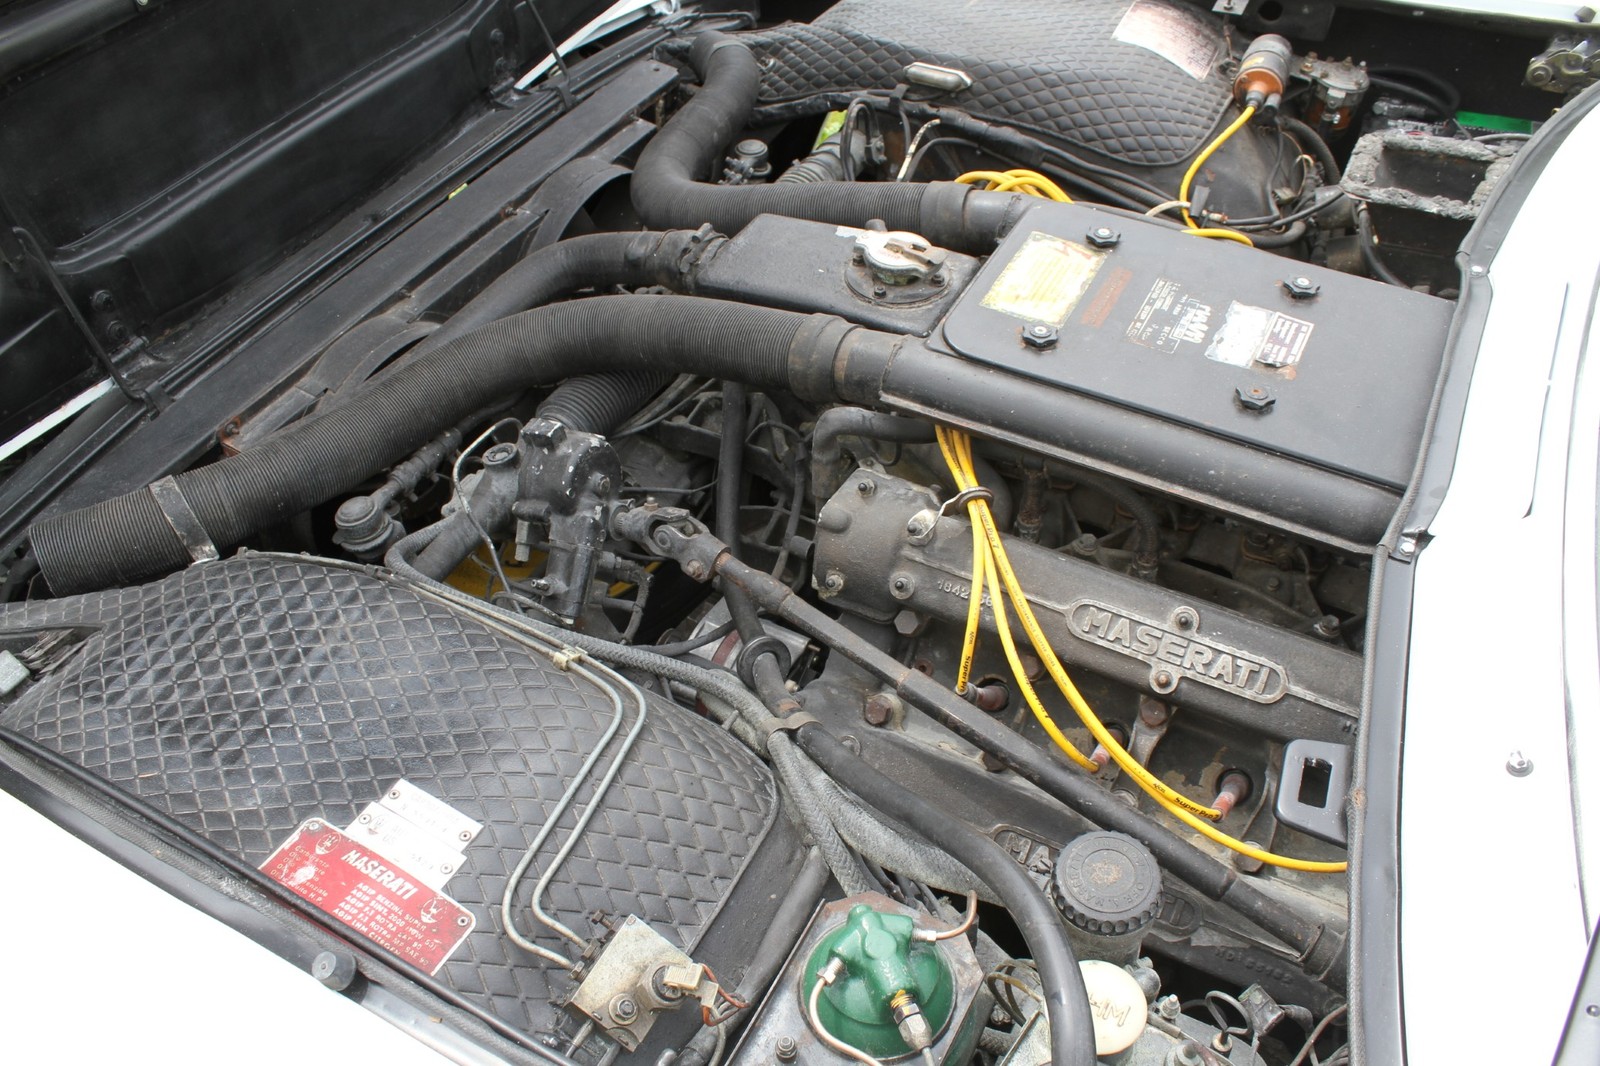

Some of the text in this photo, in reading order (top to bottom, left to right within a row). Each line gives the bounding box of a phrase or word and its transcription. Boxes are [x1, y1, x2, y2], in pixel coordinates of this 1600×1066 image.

[1081, 606, 1271, 695] MASERATI
[962, 656, 971, 678] Super
[1175, 797, 1199, 813] Super
[1199, 810, 1213, 819] Pro
[341, 850, 418, 900] MASERATI
[350, 889, 370, 901] AGIP
[356, 882, 427, 931] AGIP BENZINA SUPER
[333, 908, 352, 920] AGIP
[351, 920, 368, 932] LHM
[338, 902, 358, 914] AGIP
[344, 896, 364, 907] AGIP
[375, 914, 397, 932] ROTRA
